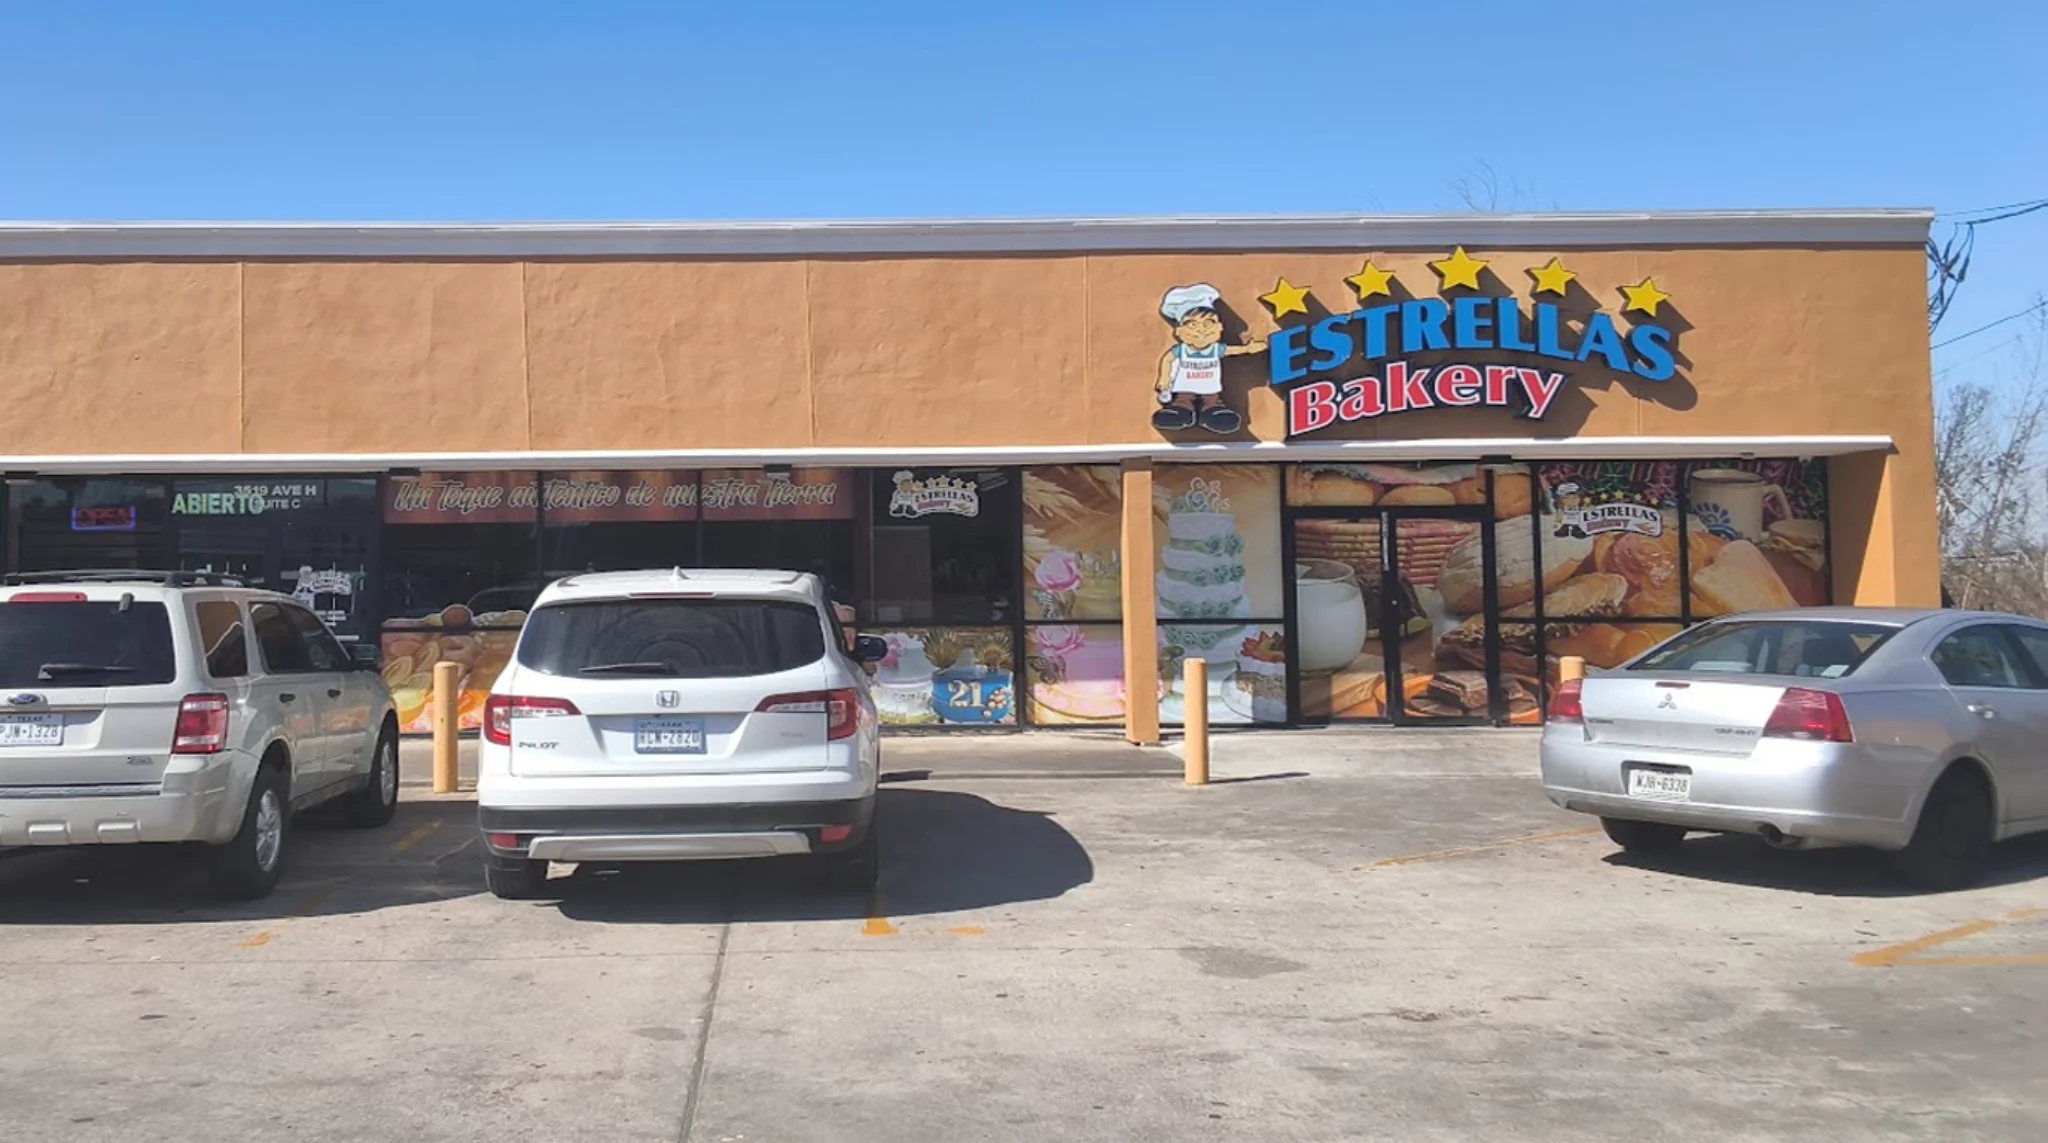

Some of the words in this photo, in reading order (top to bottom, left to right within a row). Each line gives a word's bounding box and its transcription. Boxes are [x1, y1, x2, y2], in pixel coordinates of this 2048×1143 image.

[1270, 297, 1676, 384] ESTRELLAS
[1290, 361, 1564, 436] Bakery
[271, 485, 301, 496] AVE
[305, 485, 316, 495] H
[625, 481, 658, 507] de
[171, 493, 264, 514] ABIERTO
[291, 499, 301, 509] C
[1583, 506, 1658, 521] ESTRELLAS
[948, 680, 985, 707] 21
